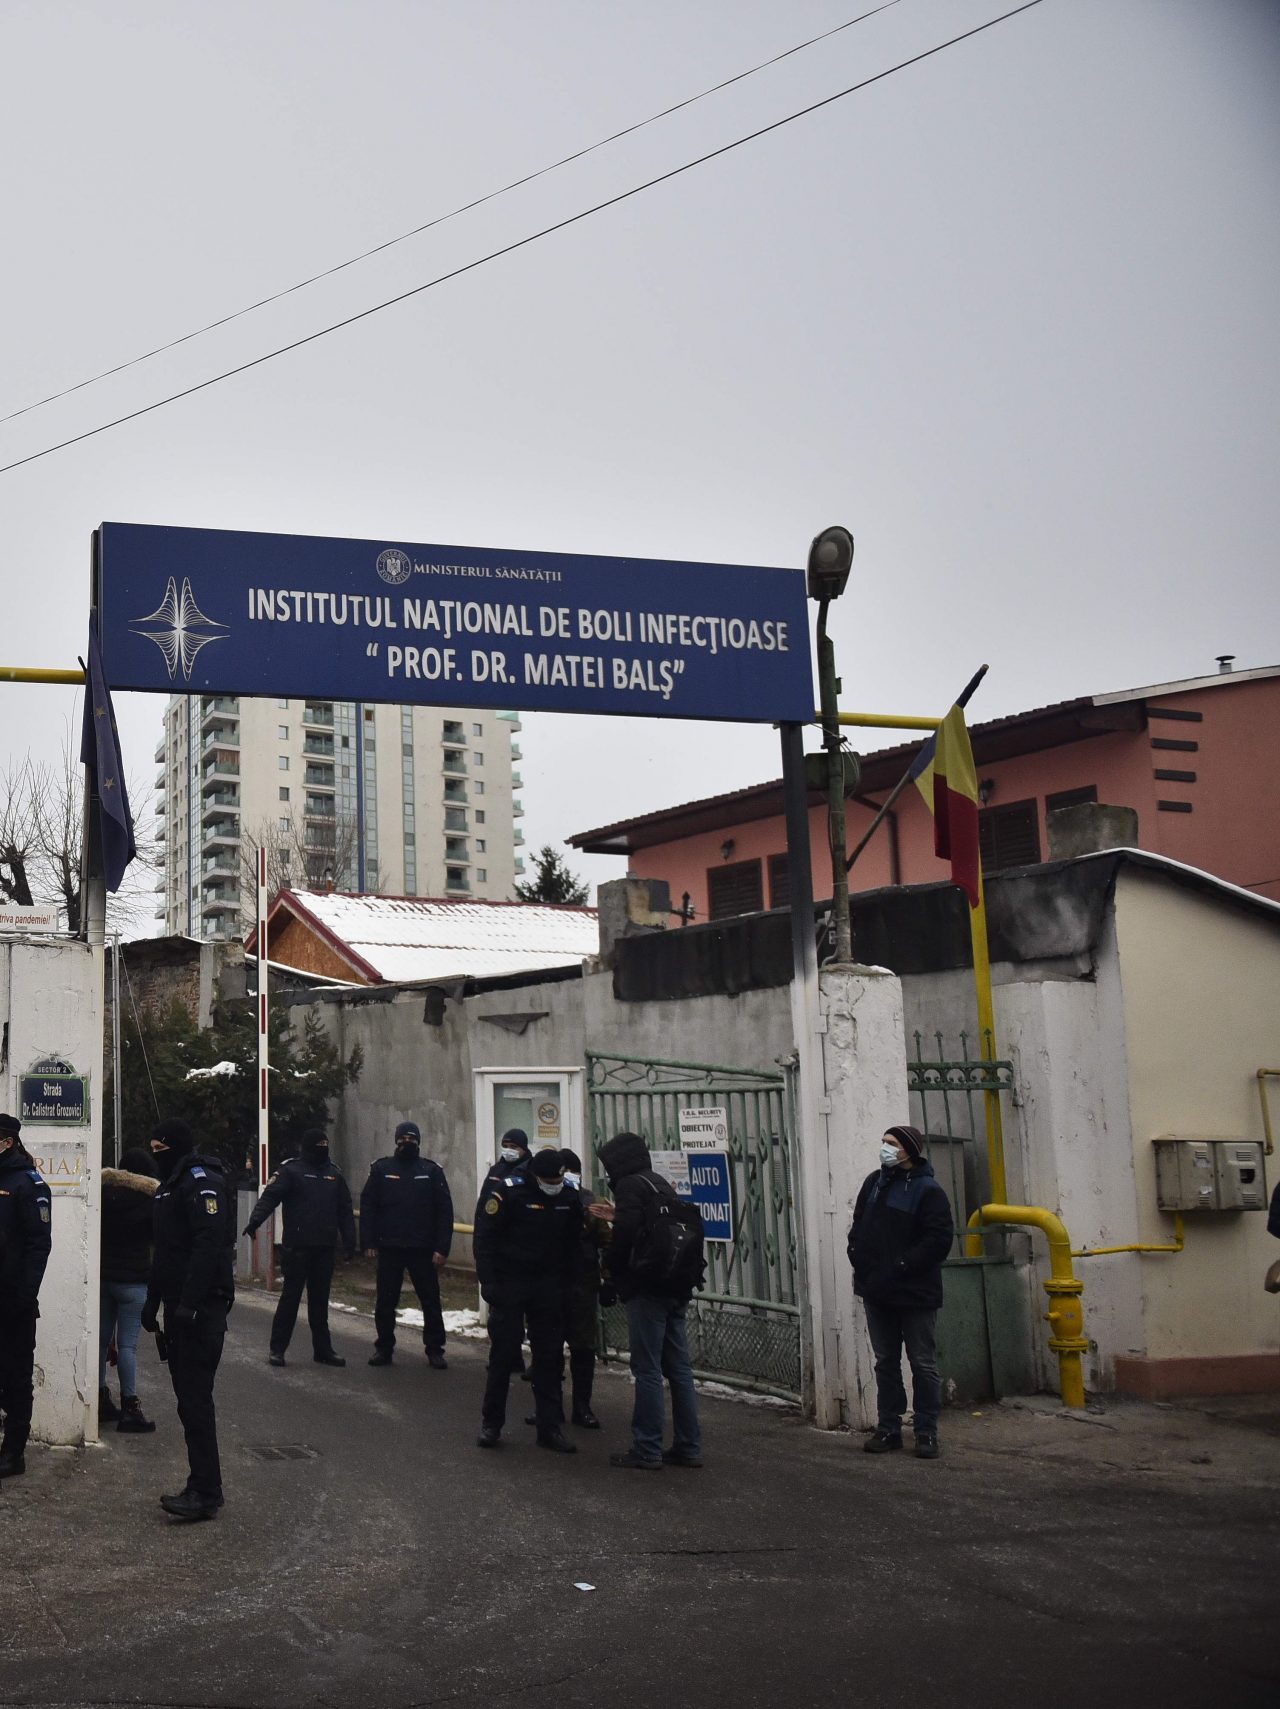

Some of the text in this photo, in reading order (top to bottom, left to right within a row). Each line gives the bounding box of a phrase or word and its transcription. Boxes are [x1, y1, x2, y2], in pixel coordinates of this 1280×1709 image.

[413, 563, 493, 578] MINISTERUL
[248, 588, 397, 628] INSTITUTUL
[539, 606, 572, 638] DE
[577, 608, 633, 642] BOLI
[387, 645, 463, 681] PROF.
[471, 649, 516, 684] DR.
[524, 652, 604, 689] MATEI
[43, 1082, 62, 1097] Strada
[22, 1102, 82, 1118] Dr. Calistrat Grozovici
[681, 1124, 713, 1133] OBIECTIV
[682, 1140, 716, 1149] PROTEJAT
[691, 1167, 720, 1186] AUTO
